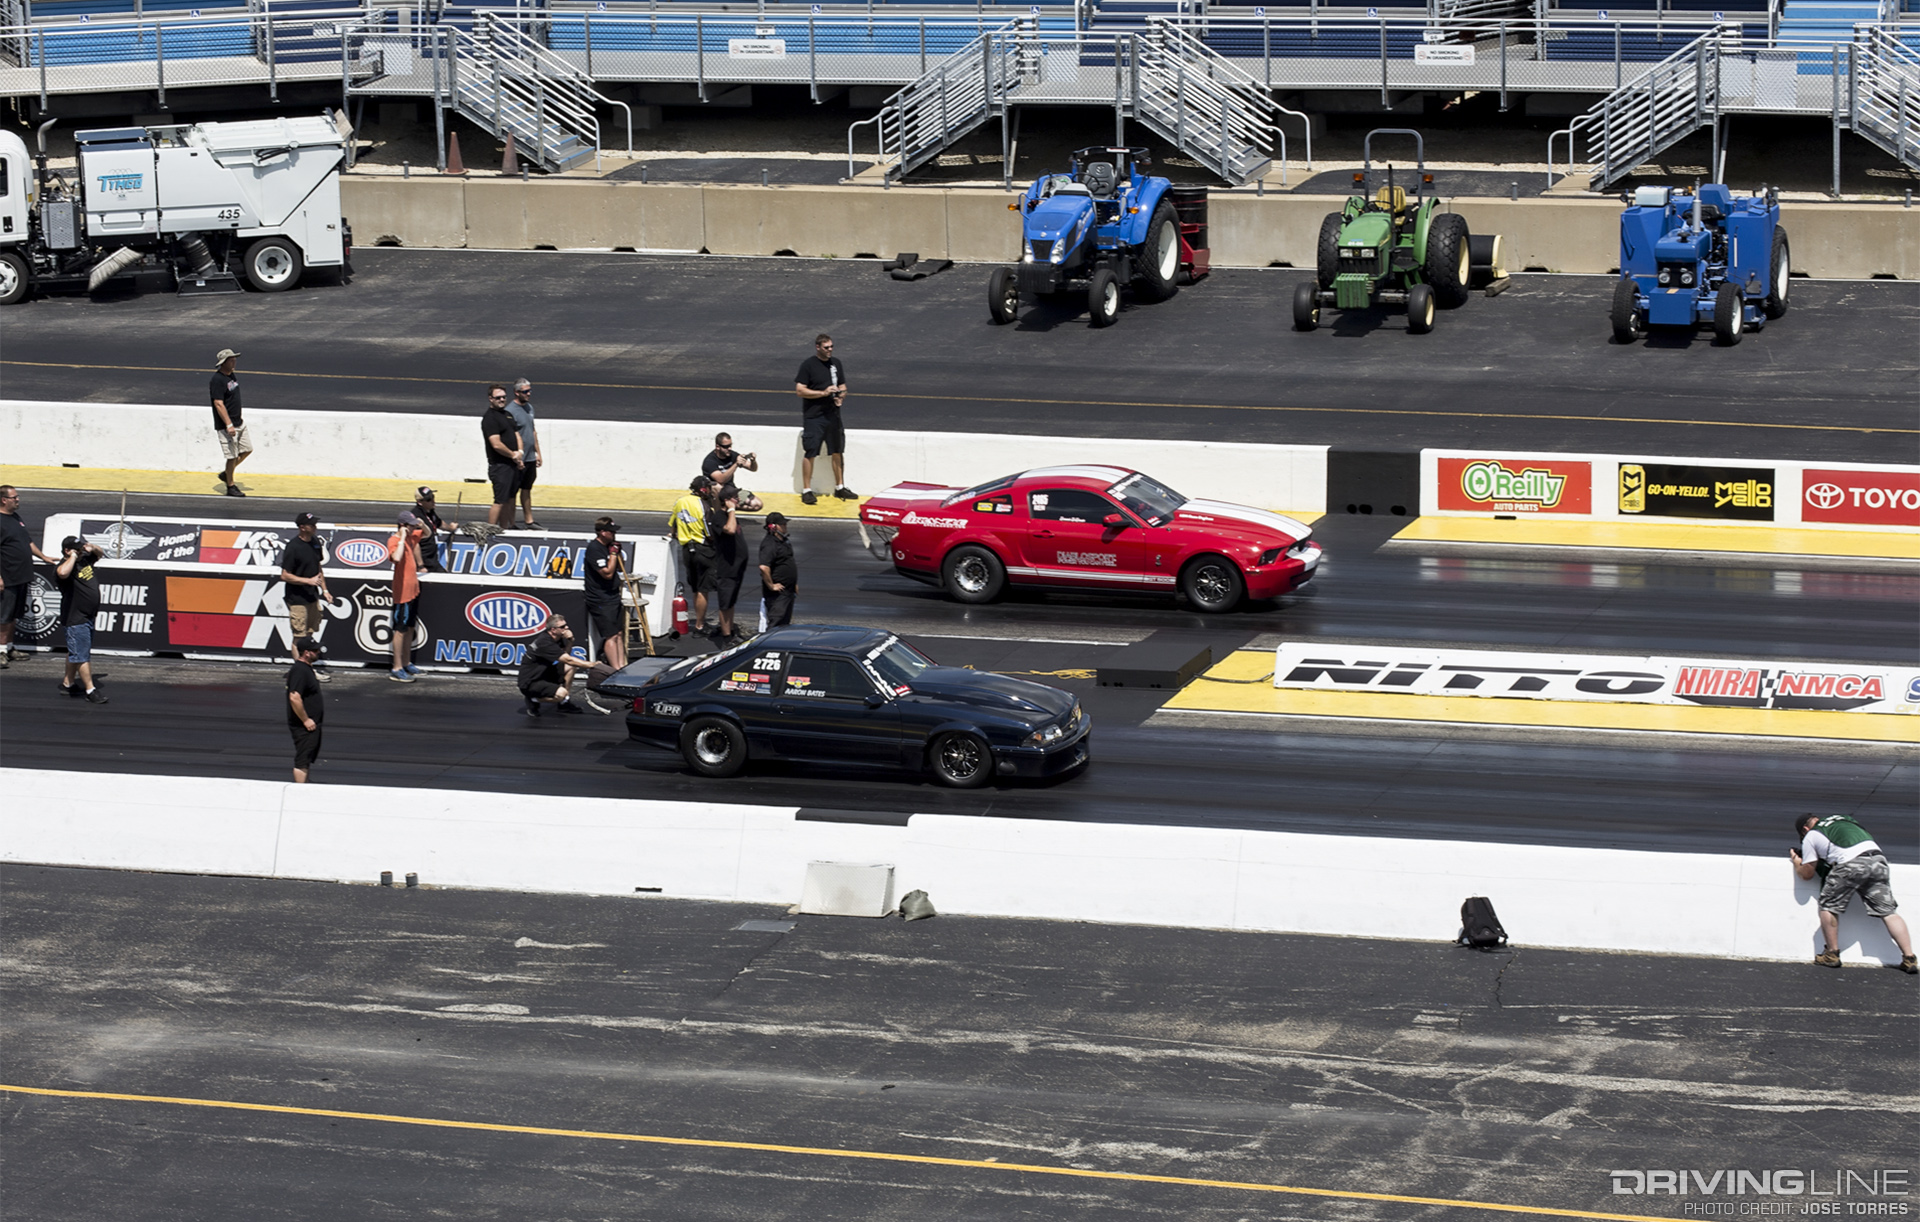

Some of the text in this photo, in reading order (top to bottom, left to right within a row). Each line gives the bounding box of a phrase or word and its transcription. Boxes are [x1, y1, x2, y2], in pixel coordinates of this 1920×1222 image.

[97, 173, 143, 193] TYMCO
[217, 209, 241, 220] 435
[1468, 467, 1559, 501] O'Reilly
[1493, 503, 1539, 512] AUTO PARTS
[158, 532, 195, 547] Home
[157, 545, 195, 561] of the
[343, 544, 381, 563] NHRA
[99, 584, 148, 606] HOME
[364, 594, 393, 608] ROU
[95, 611, 155, 634] OF THE
[479, 600, 540, 629] NHRA
[435, 639, 588, 666] NATIONS
[753, 658, 781, 671] 2726
[784, 687, 826, 697] AARON BATES
[1674, 667, 1760, 698] NMRA
[1776, 673, 1884, 699] NMCA
